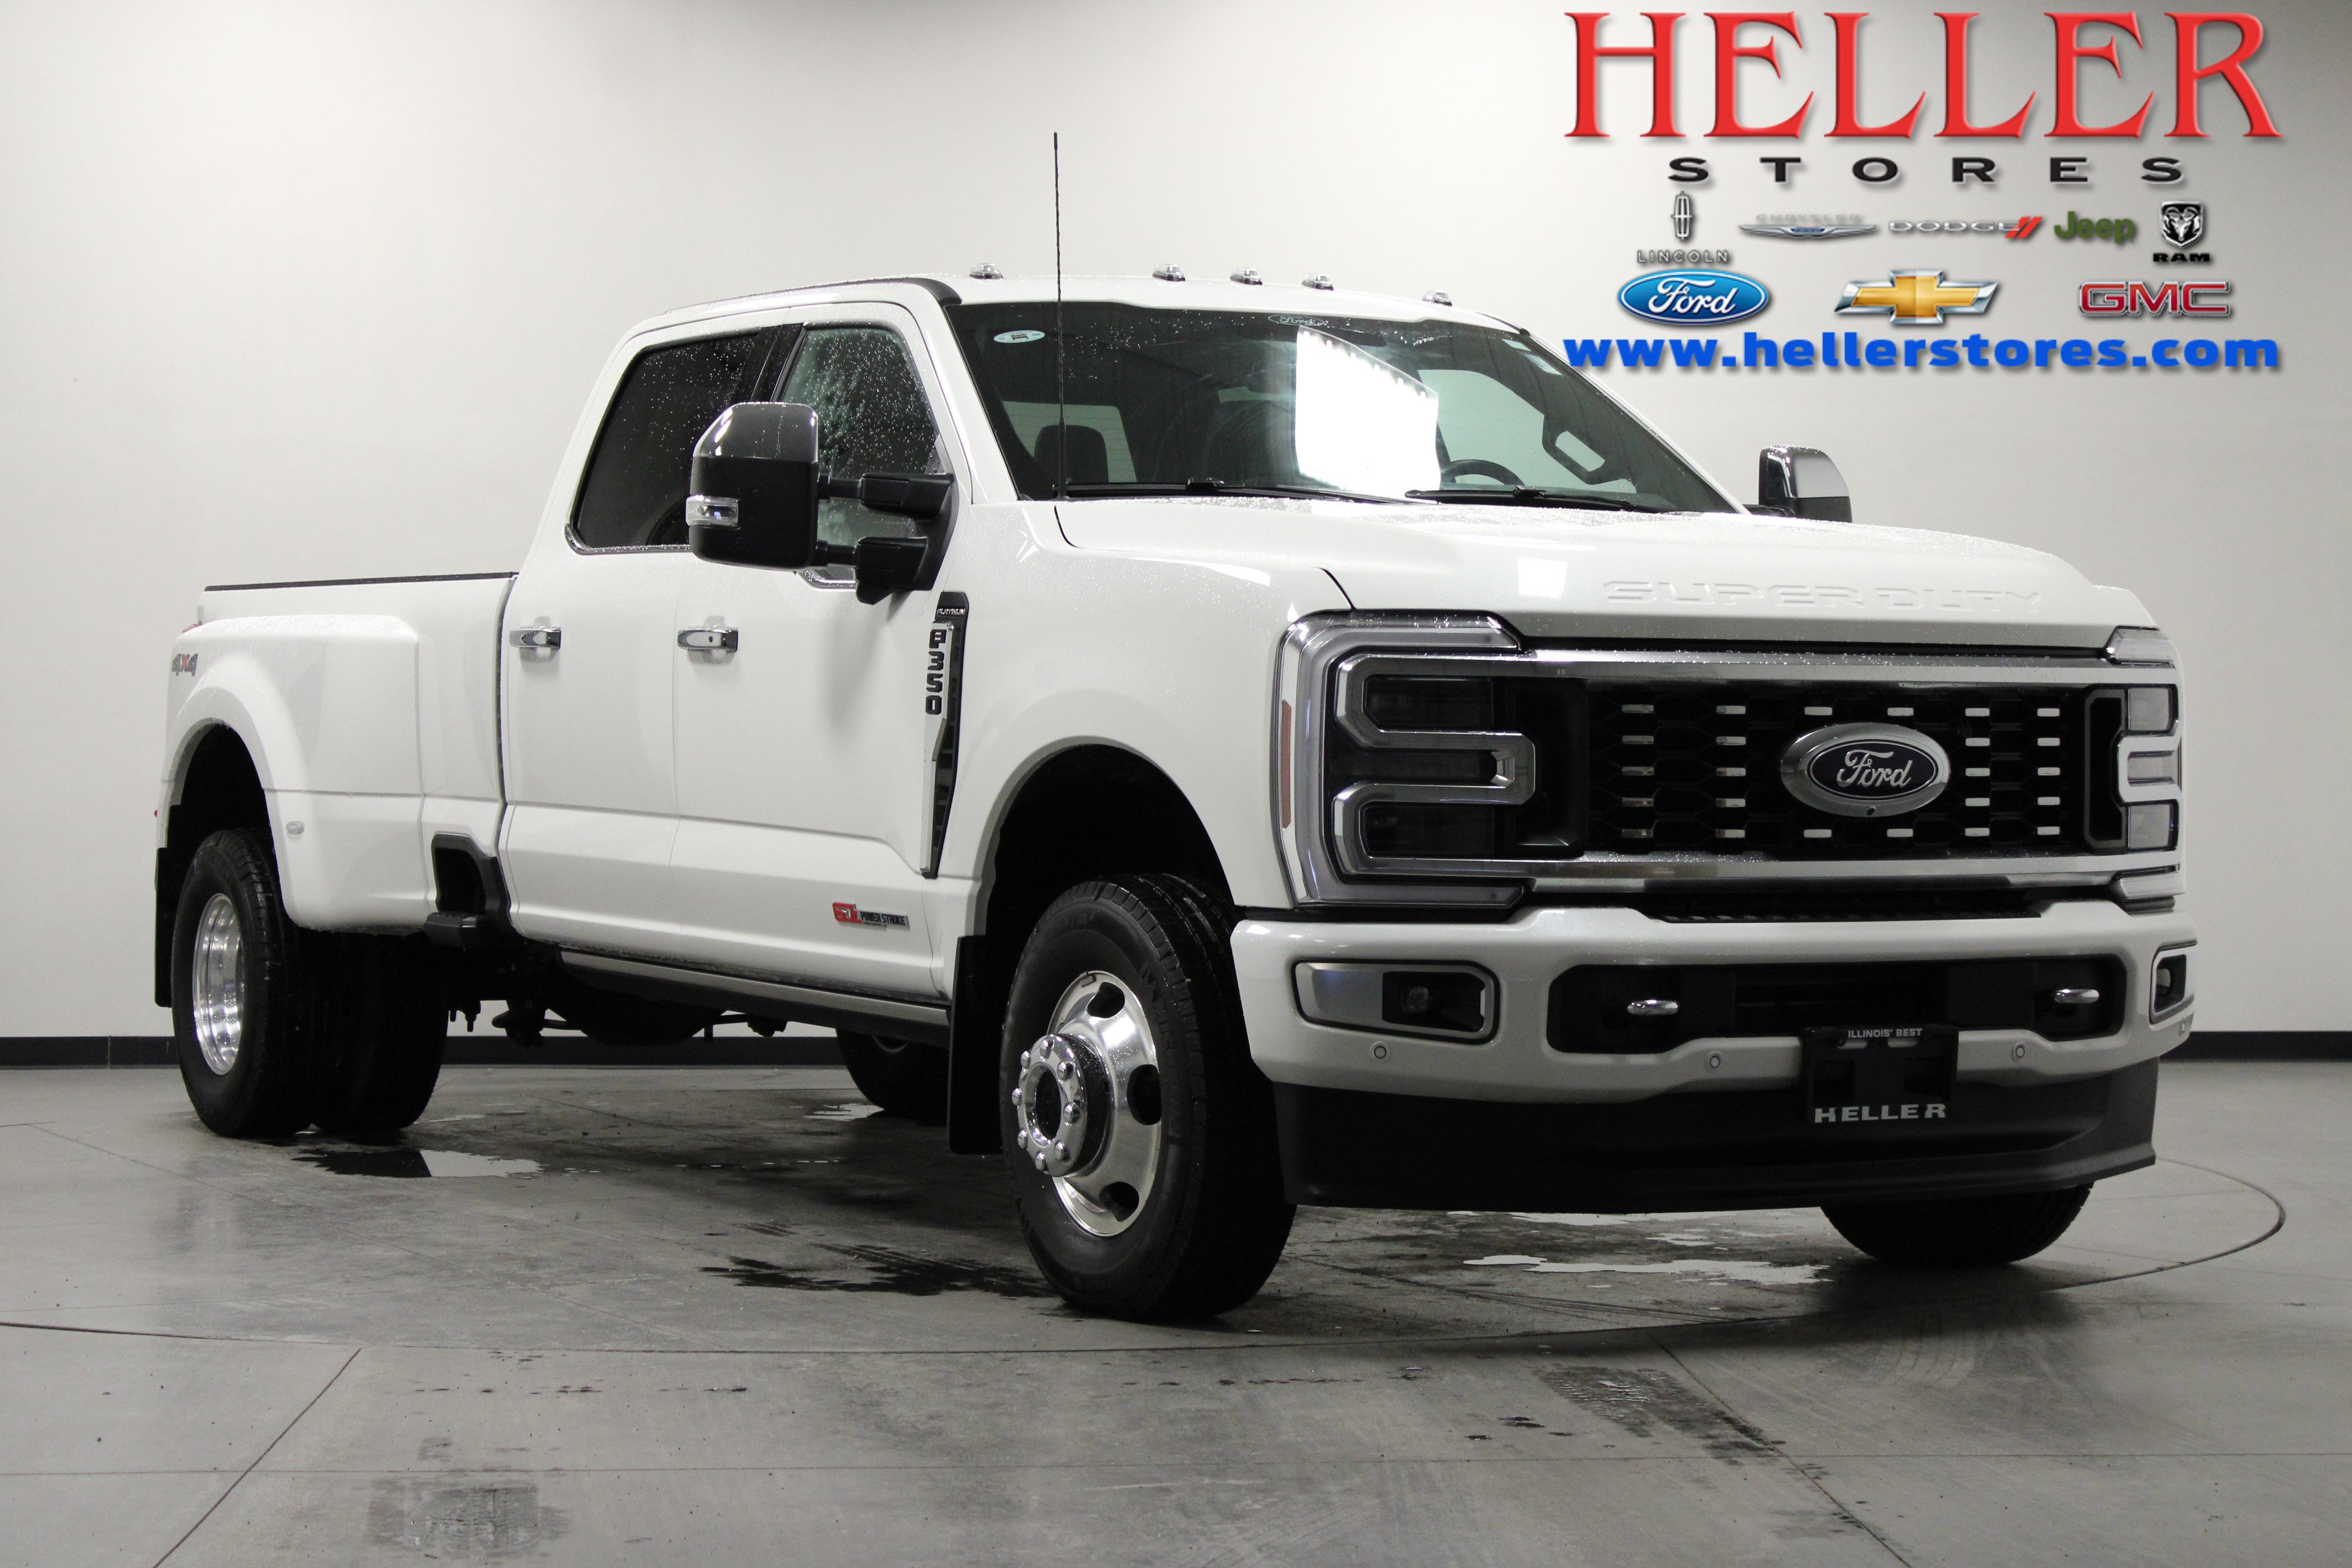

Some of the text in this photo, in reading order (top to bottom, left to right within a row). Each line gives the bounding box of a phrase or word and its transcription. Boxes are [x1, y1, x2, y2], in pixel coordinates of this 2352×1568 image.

[1603, 581, 2040, 613] SUPER DUTY
[1836, 749, 1913, 788] Ford
[1896, 1028, 1922, 1037] BEST
[1814, 1103, 1946, 1123] HELLER
